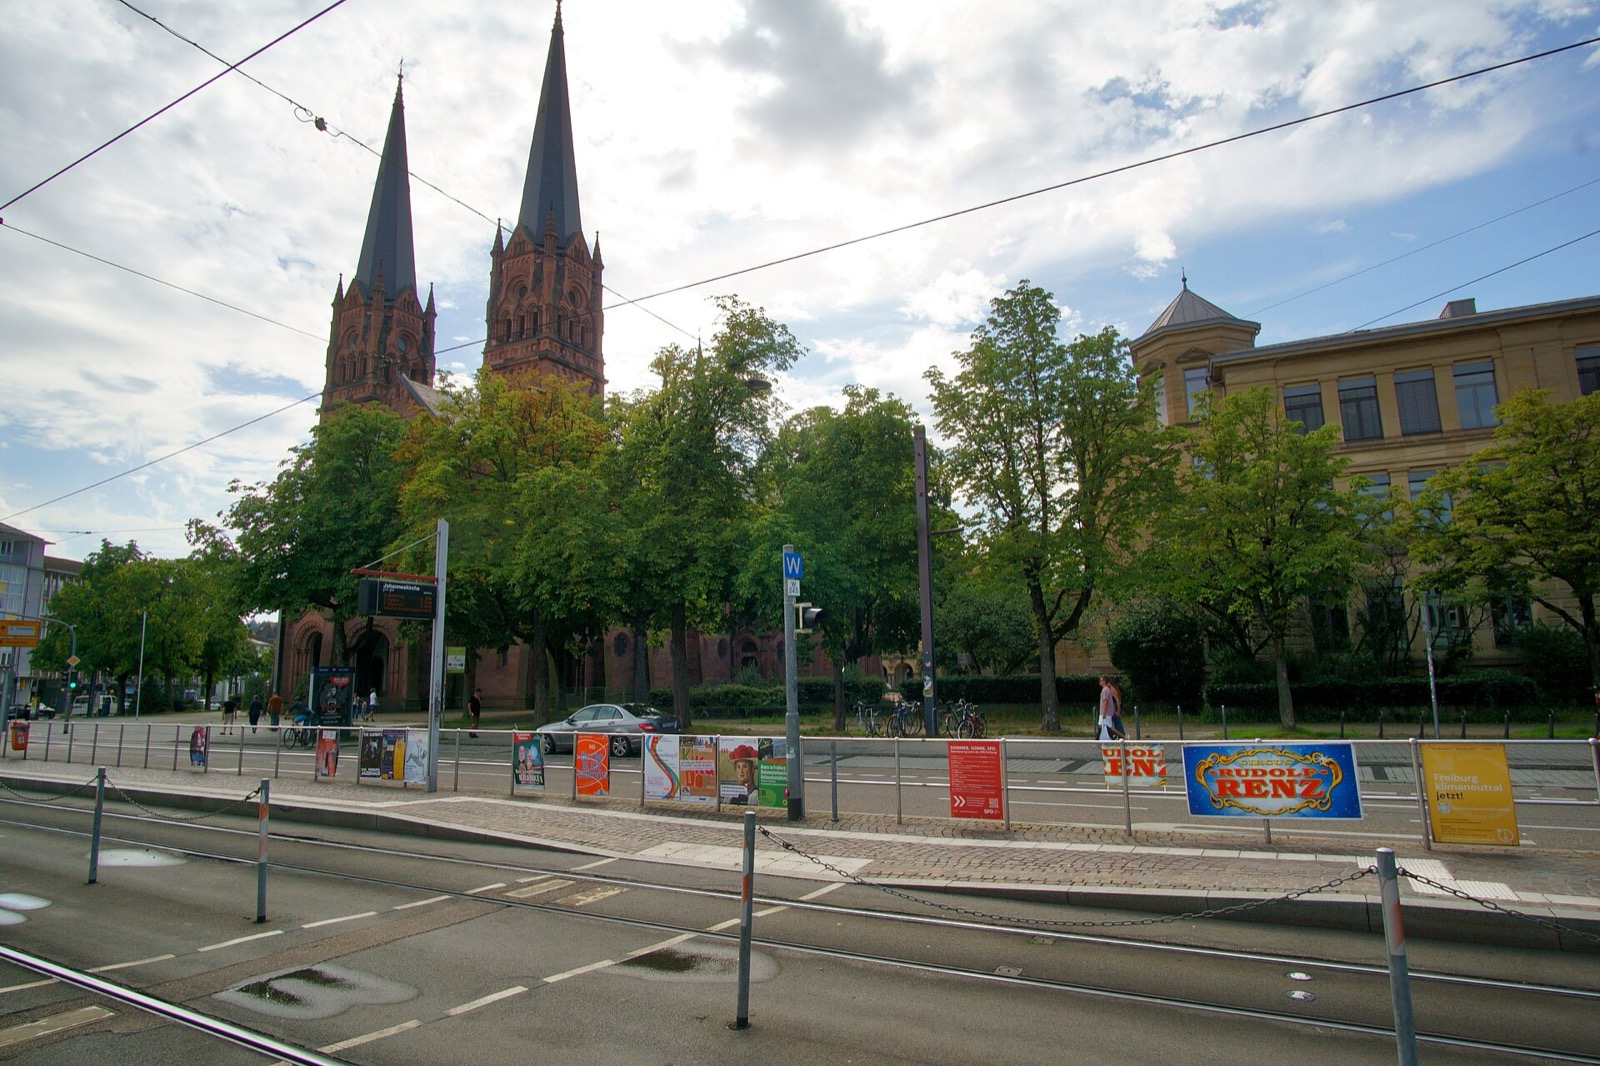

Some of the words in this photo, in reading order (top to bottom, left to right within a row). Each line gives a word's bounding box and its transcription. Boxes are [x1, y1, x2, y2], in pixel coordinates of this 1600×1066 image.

[786, 556, 800, 575] W
[383, 583, 420, 592] Johanneskirche
[1218, 768, 1317, 777] RUDOLF
[1434, 773, 1478, 784] Freiburg
[1215, 779, 1325, 799] RENZ
[1434, 782, 1503, 792] klimaneutral
[1436, 791, 1464, 801] jetzt!
